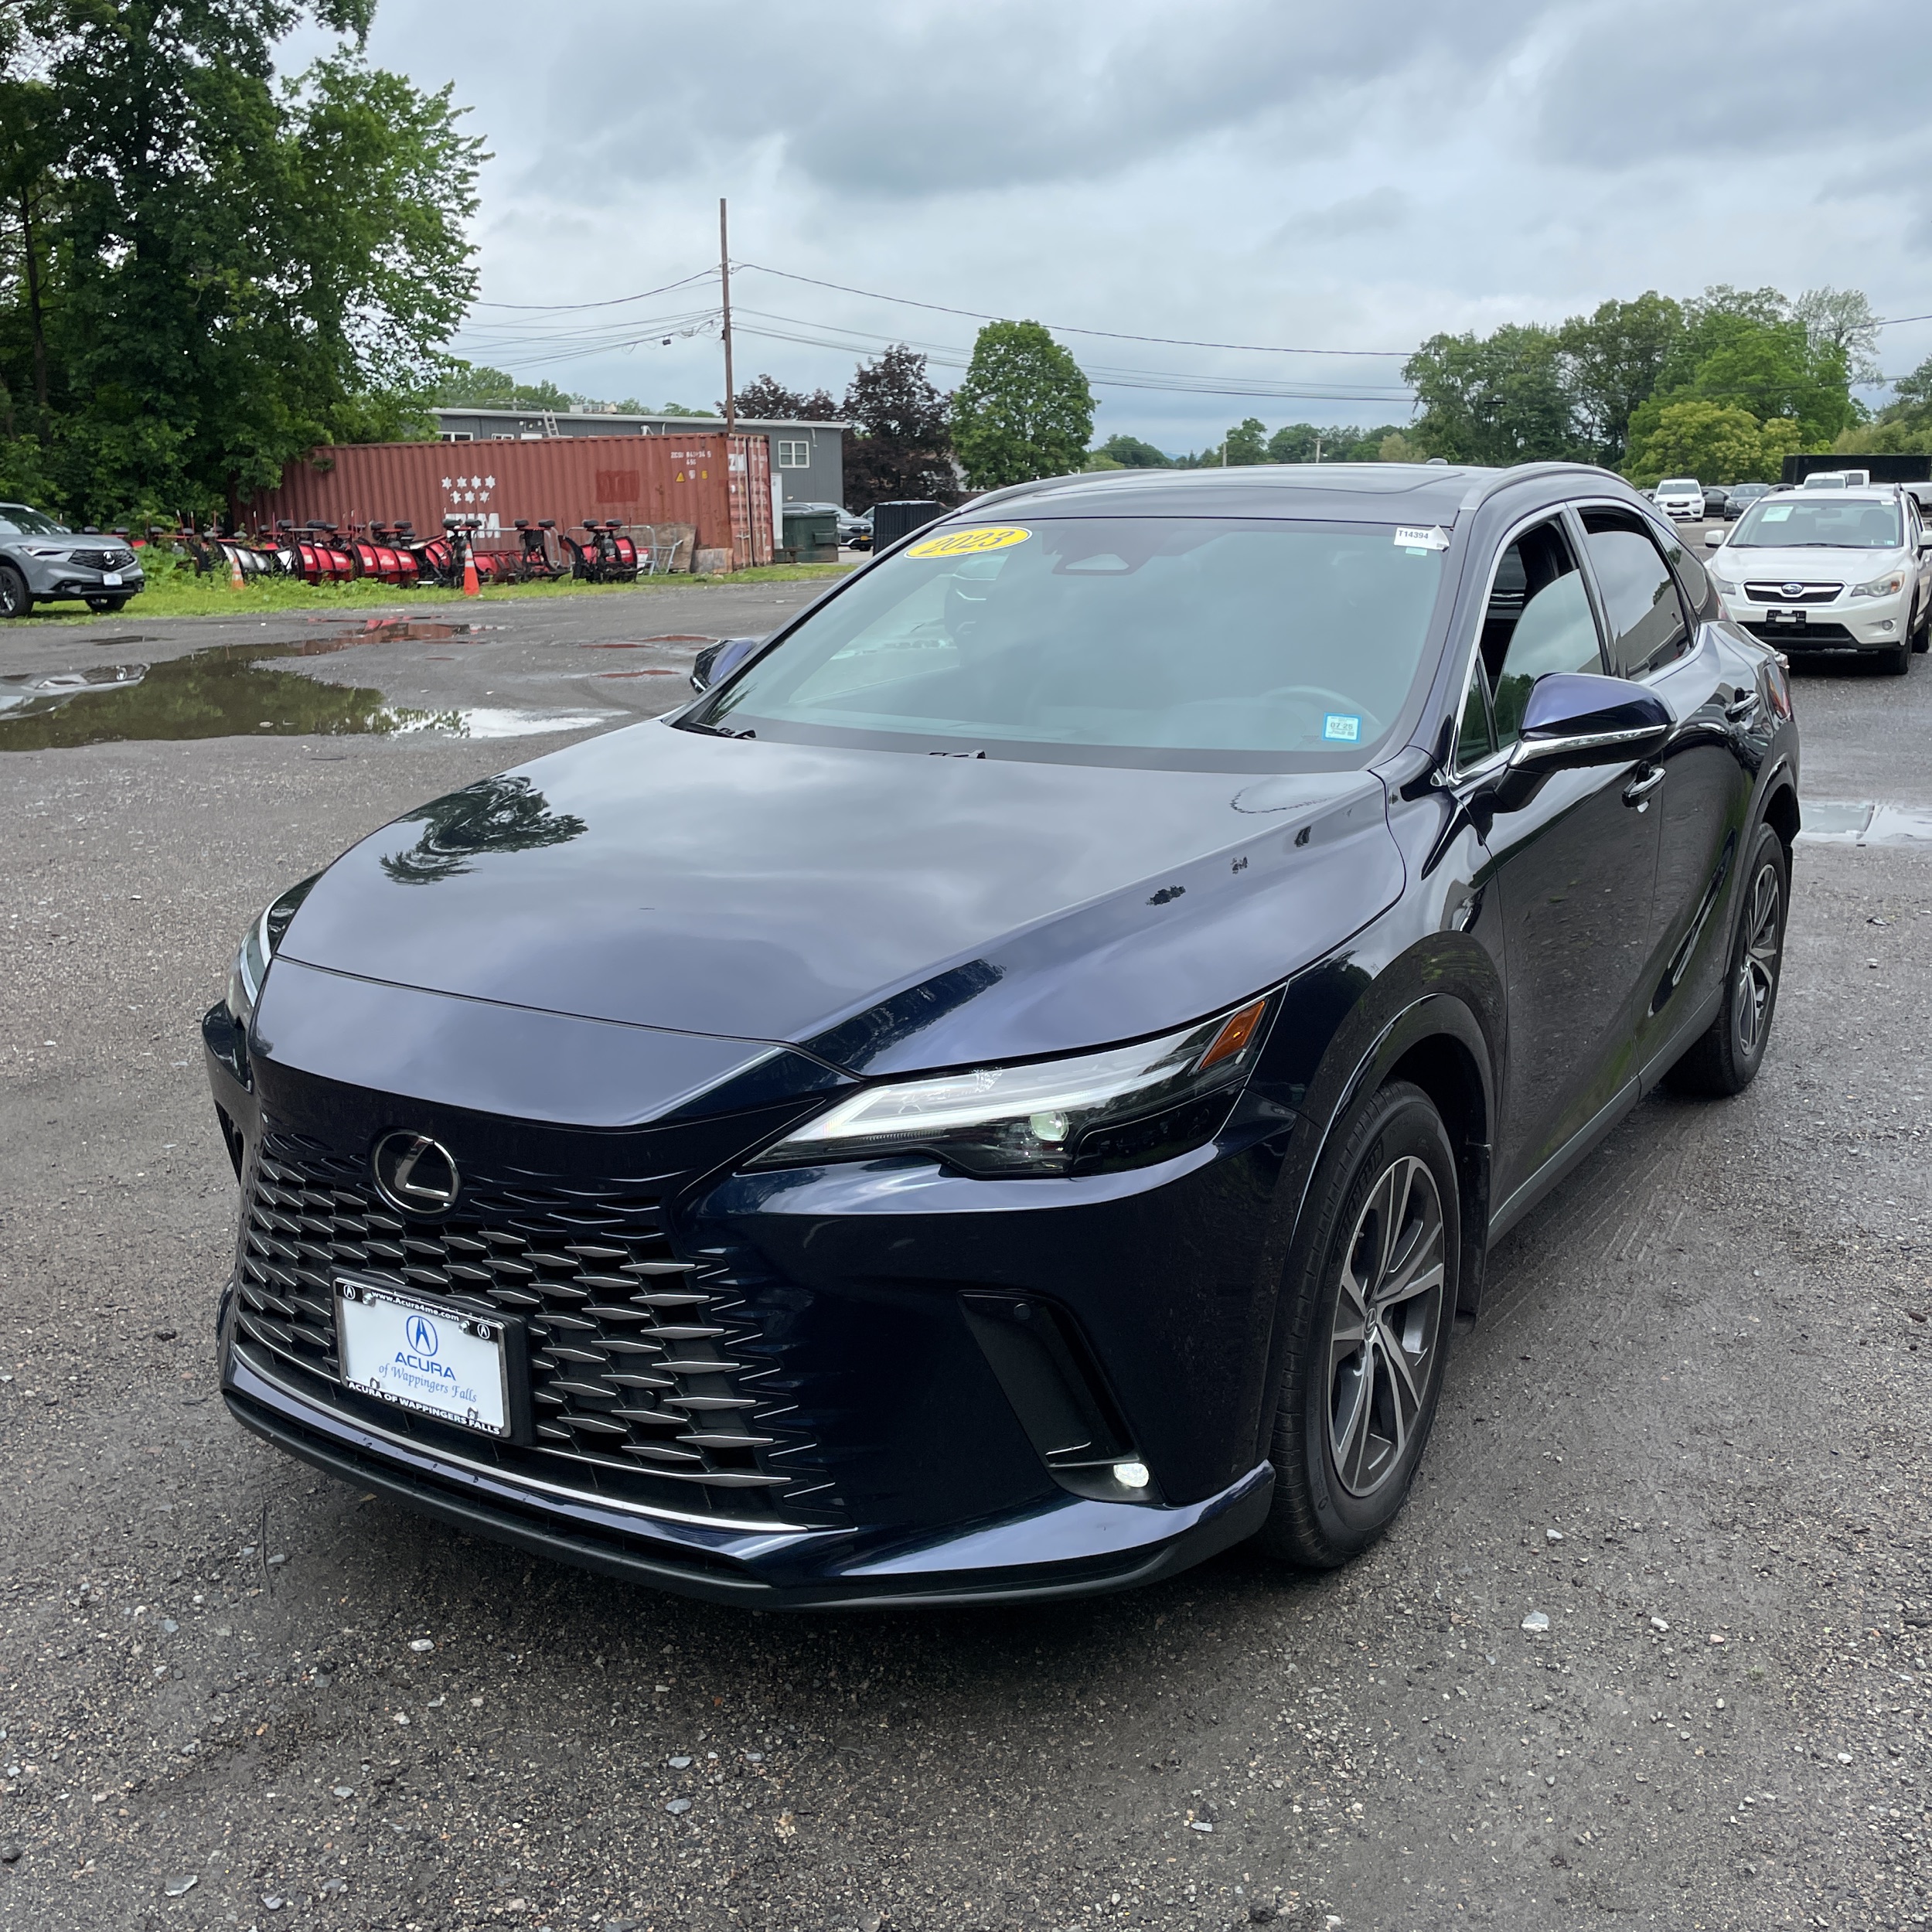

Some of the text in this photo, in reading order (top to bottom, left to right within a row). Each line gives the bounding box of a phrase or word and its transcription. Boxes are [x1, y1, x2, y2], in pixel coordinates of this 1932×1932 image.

[917, 530, 1016, 555] 2023
[1398, 530, 1429, 540] T14394
[372, 1291, 459, 1322] www.Acura4me.com
[395, 1351, 456, 1382] ACURA
[379, 1363, 477, 1402] of Wappingers Falls
[348, 1382, 500, 1435] ACURA OF WAPPINGERS FALLS
